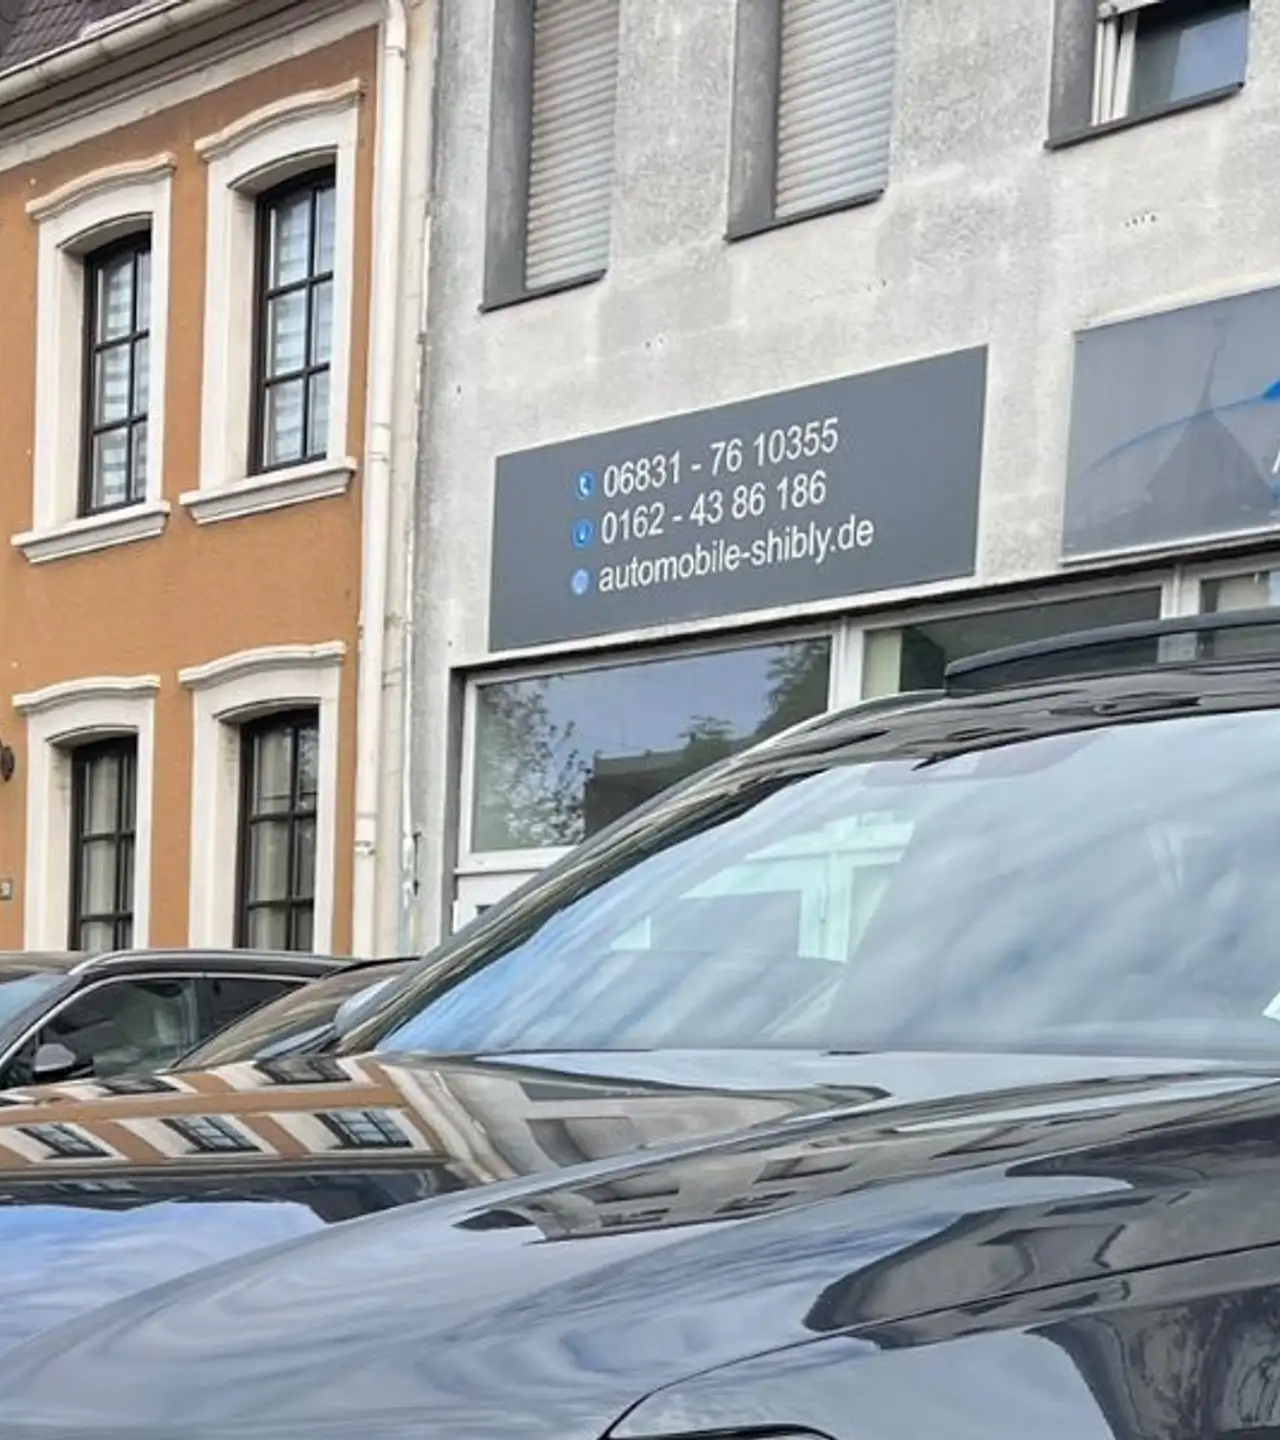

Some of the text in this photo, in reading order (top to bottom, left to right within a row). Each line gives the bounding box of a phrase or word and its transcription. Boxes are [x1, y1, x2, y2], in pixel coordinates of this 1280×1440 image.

[603, 451, 681, 498] 06831
[710, 438, 743, 477] 76
[753, 417, 839, 467] 10355
[601, 502, 664, 545] 0162
[690, 490, 723, 527] 43
[732, 482, 766, 520] 86
[776, 470, 827, 510] 186
[598, 514, 875, 592] automobile-shibly.de
